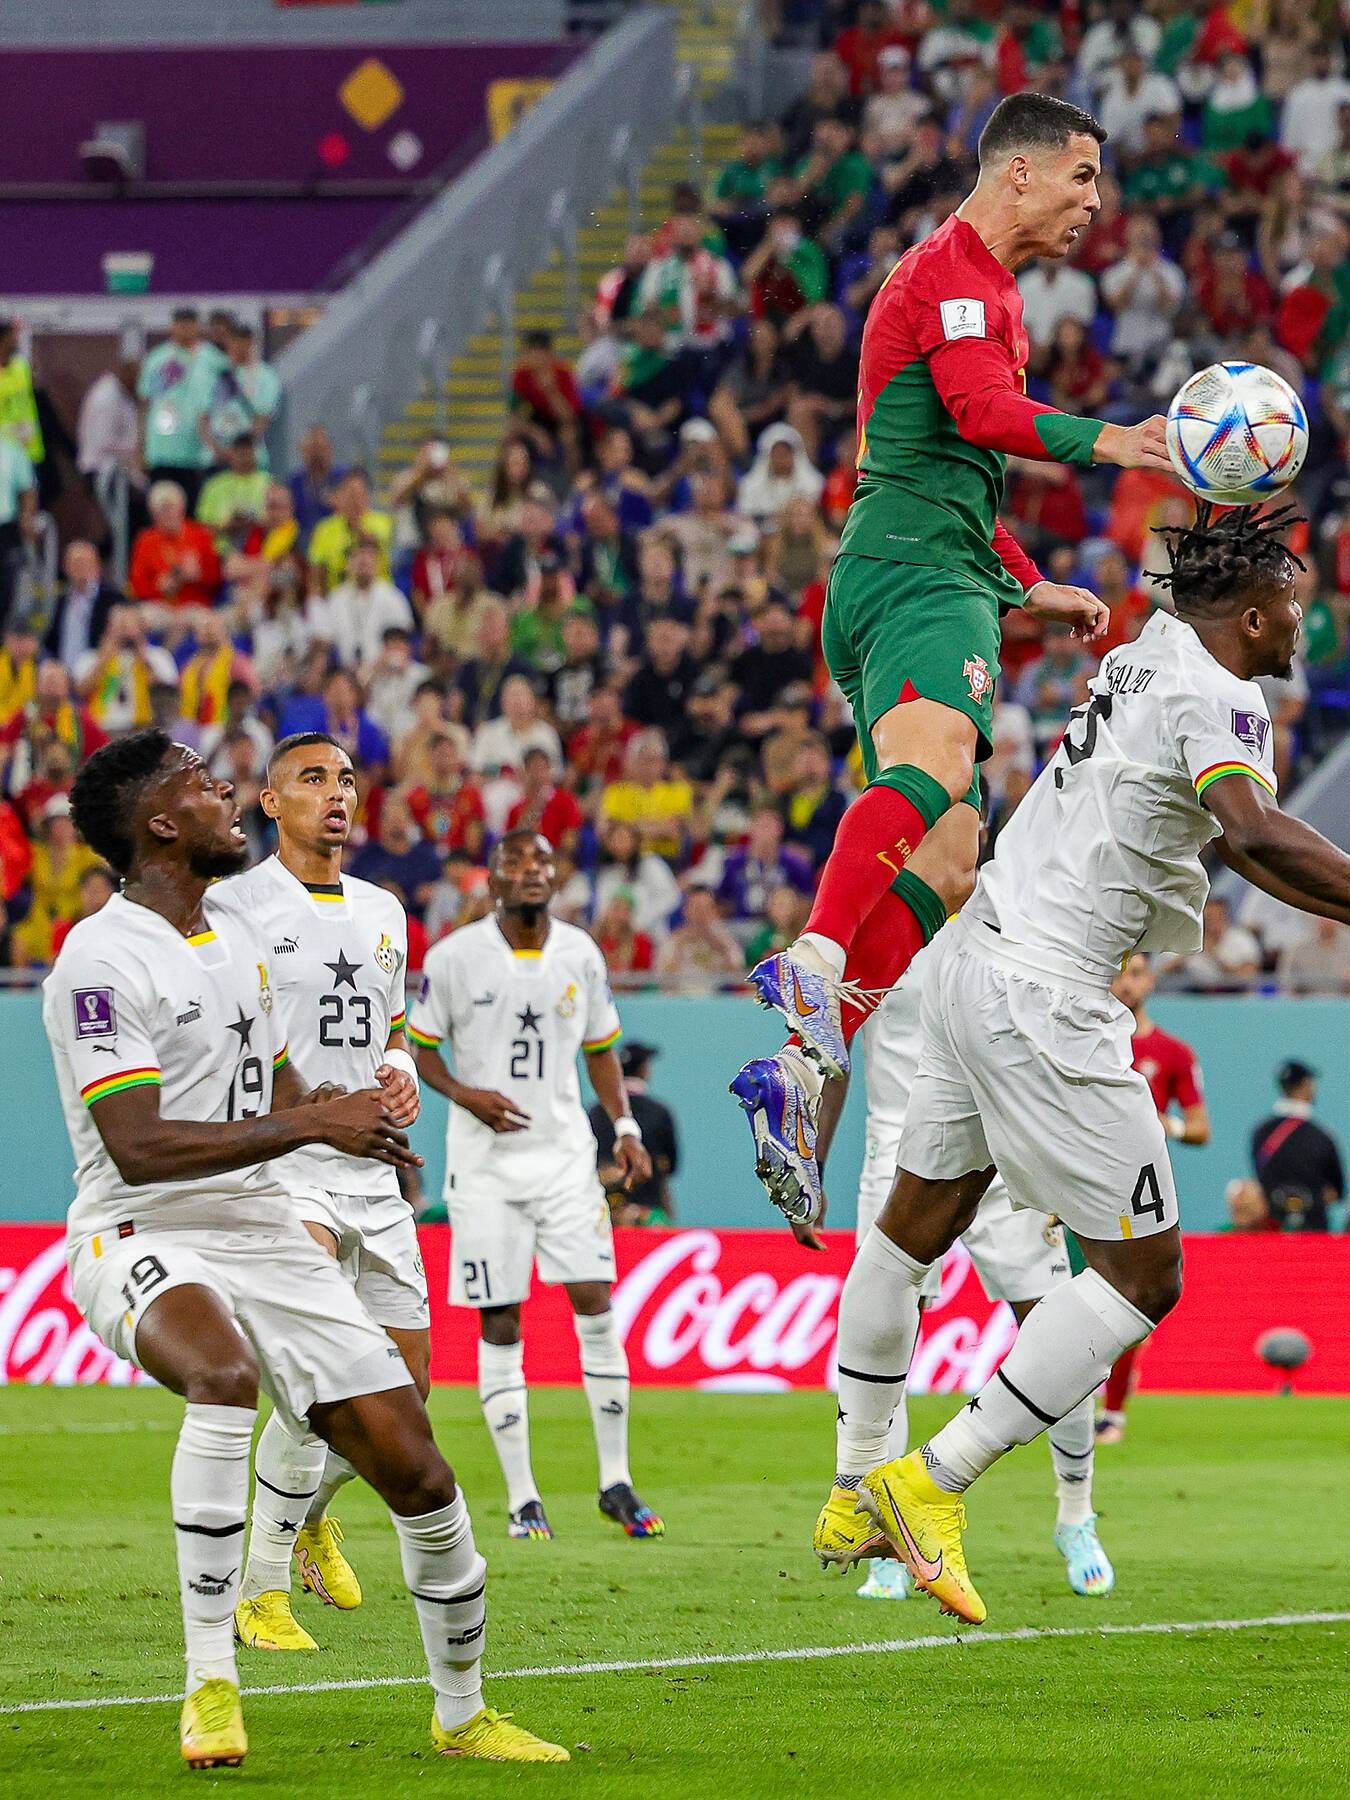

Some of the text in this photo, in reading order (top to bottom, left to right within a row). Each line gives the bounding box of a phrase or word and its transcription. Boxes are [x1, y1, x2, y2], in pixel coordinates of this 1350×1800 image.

[319, 994, 373, 1048] 23
[511, 1039, 544, 1080] 21
[226, 1056, 264, 1122] 19
[1130, 1162, 1165, 1224] 4
[463, 1259, 492, 1300] 21
